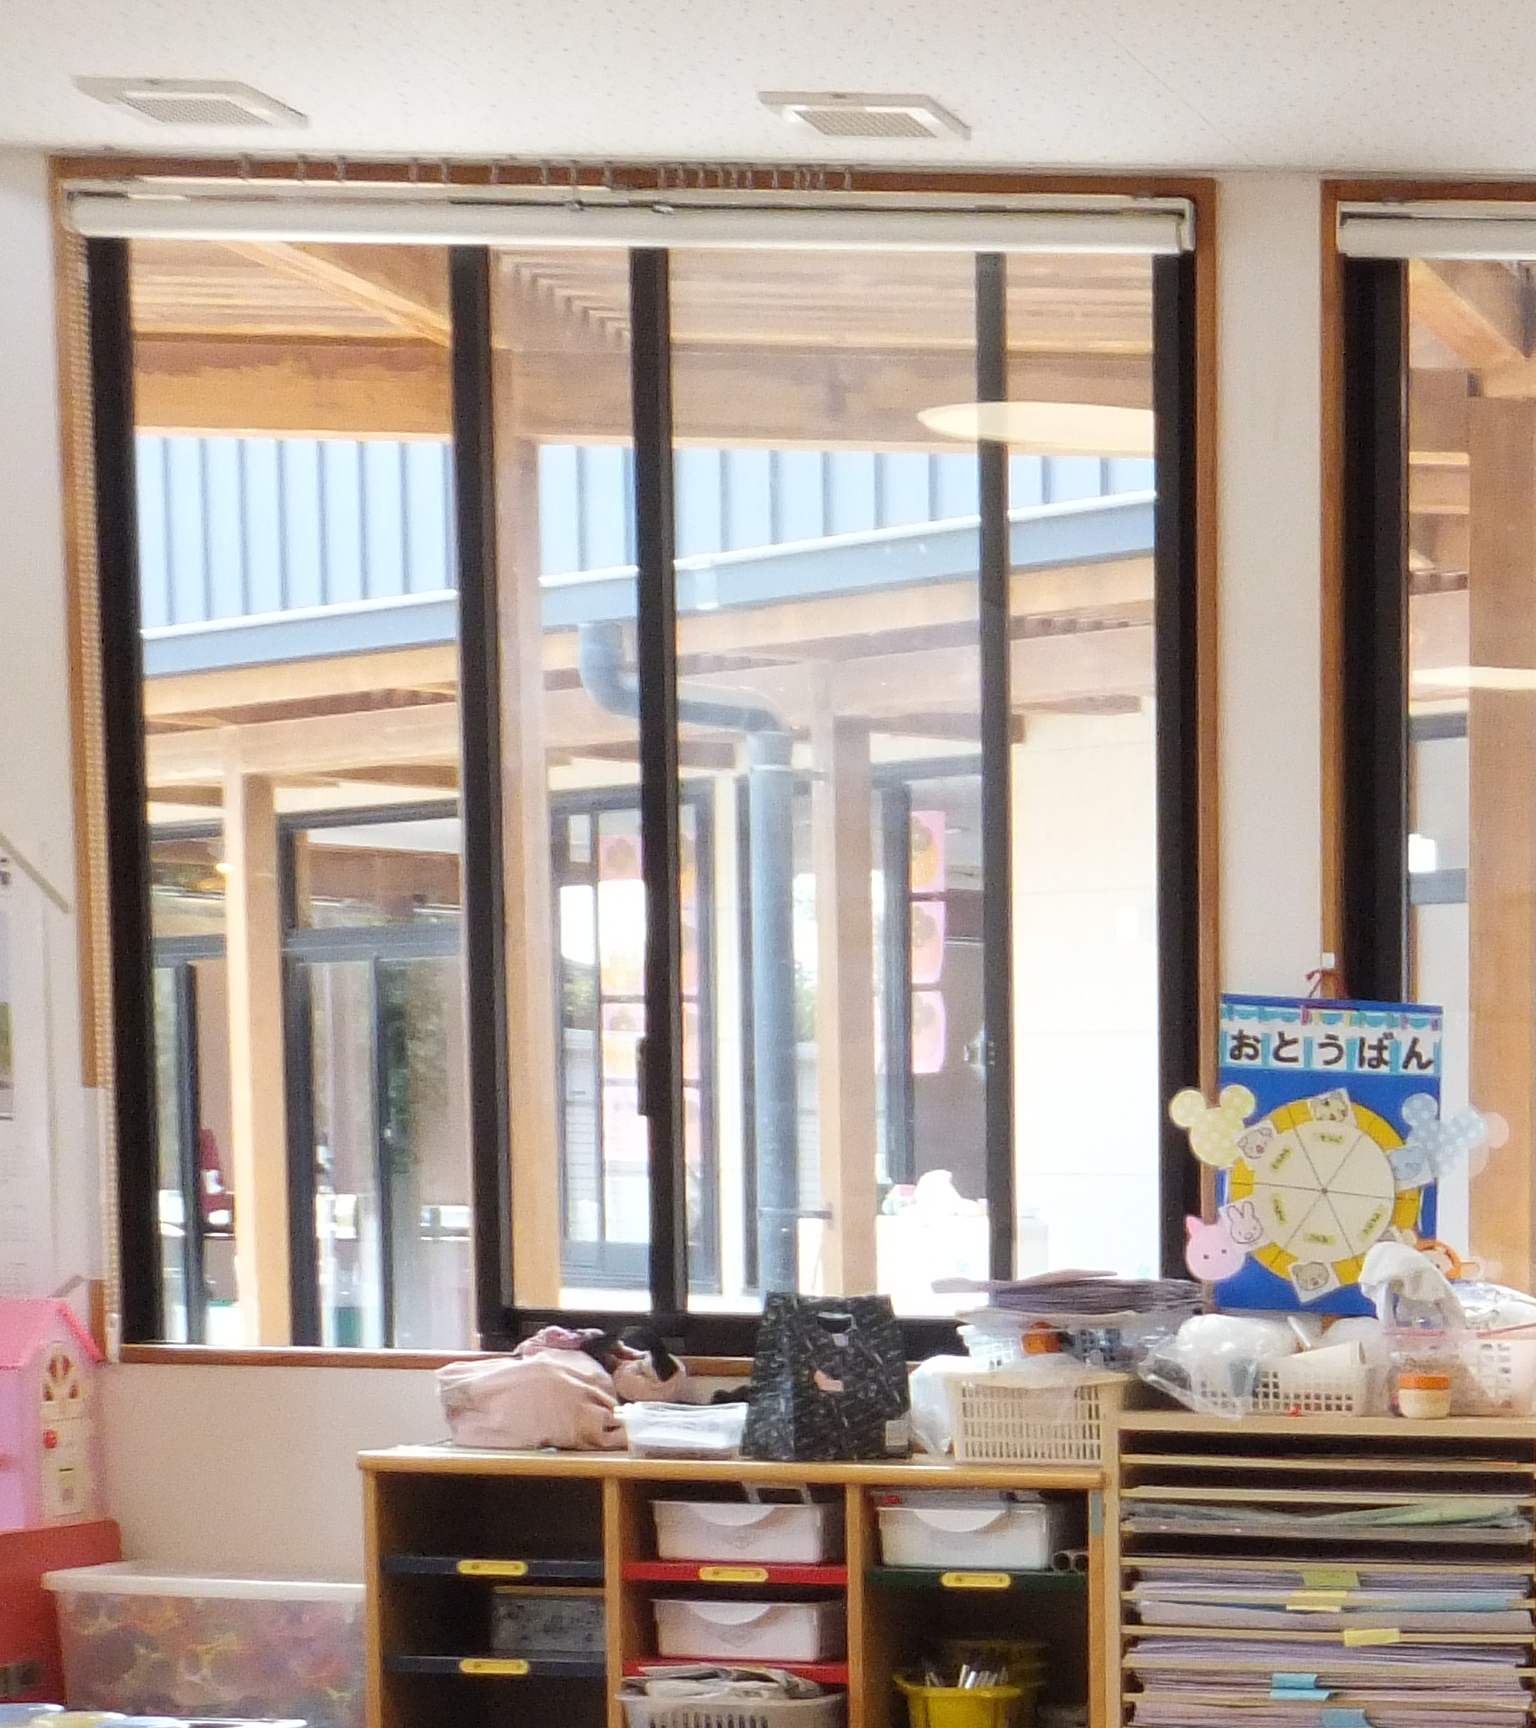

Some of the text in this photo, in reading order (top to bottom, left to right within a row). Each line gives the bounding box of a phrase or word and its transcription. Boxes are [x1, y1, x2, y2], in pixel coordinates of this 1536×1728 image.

[1229, 1028, 1435, 1071] おとうばん
